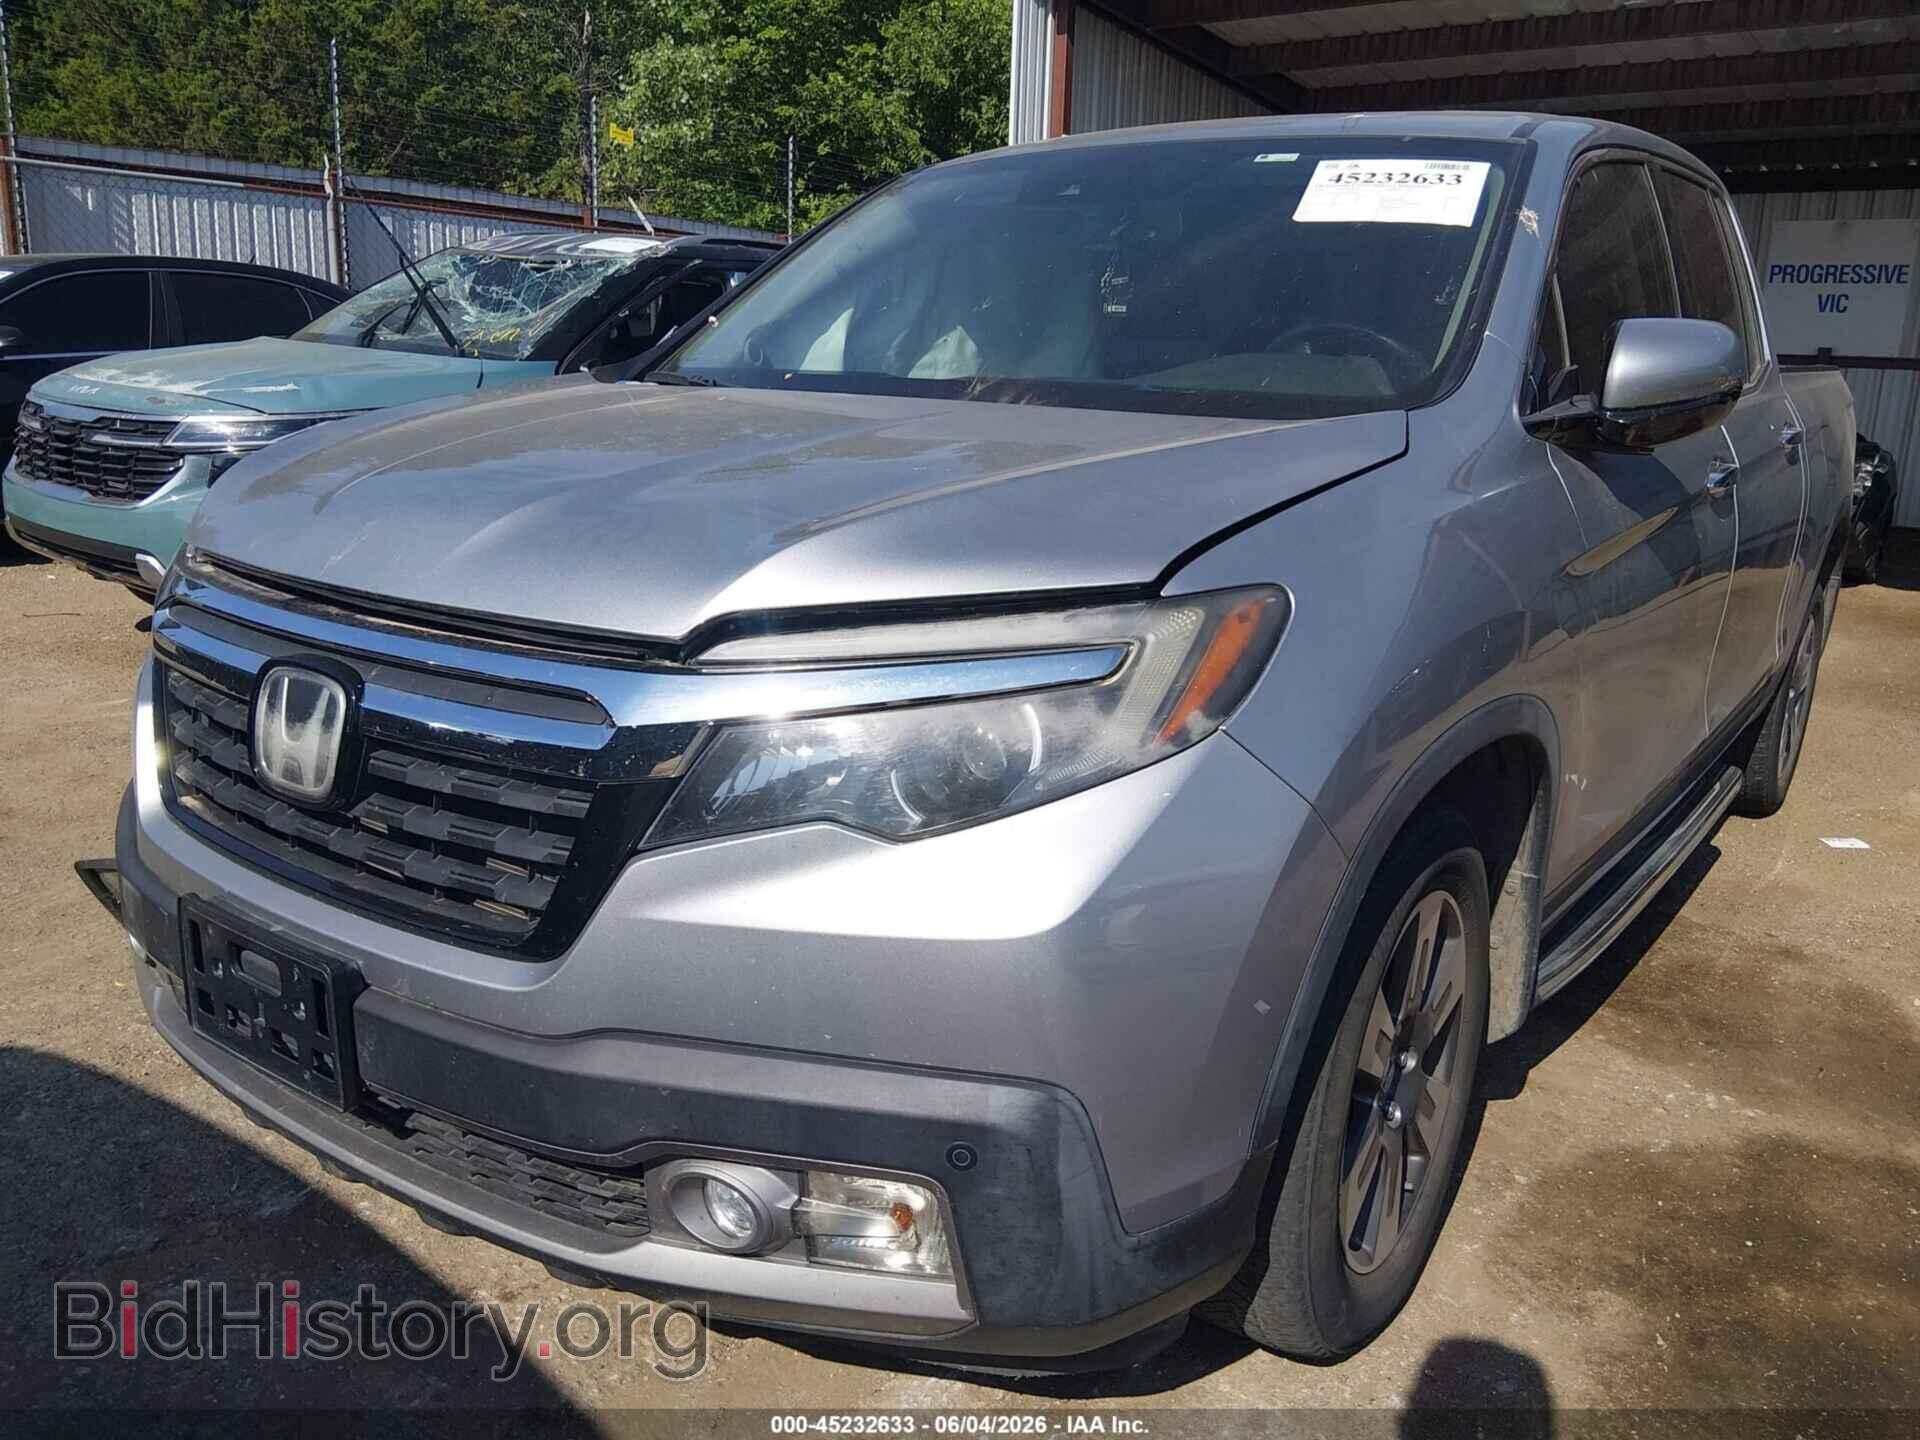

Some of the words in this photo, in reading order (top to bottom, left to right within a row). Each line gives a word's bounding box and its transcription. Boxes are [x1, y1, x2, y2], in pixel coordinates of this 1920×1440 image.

[1327, 171, 1464, 186] 45232633
[1768, 263, 1911, 285] PROGRESSIVE
[1817, 293, 1850, 314] VIC
